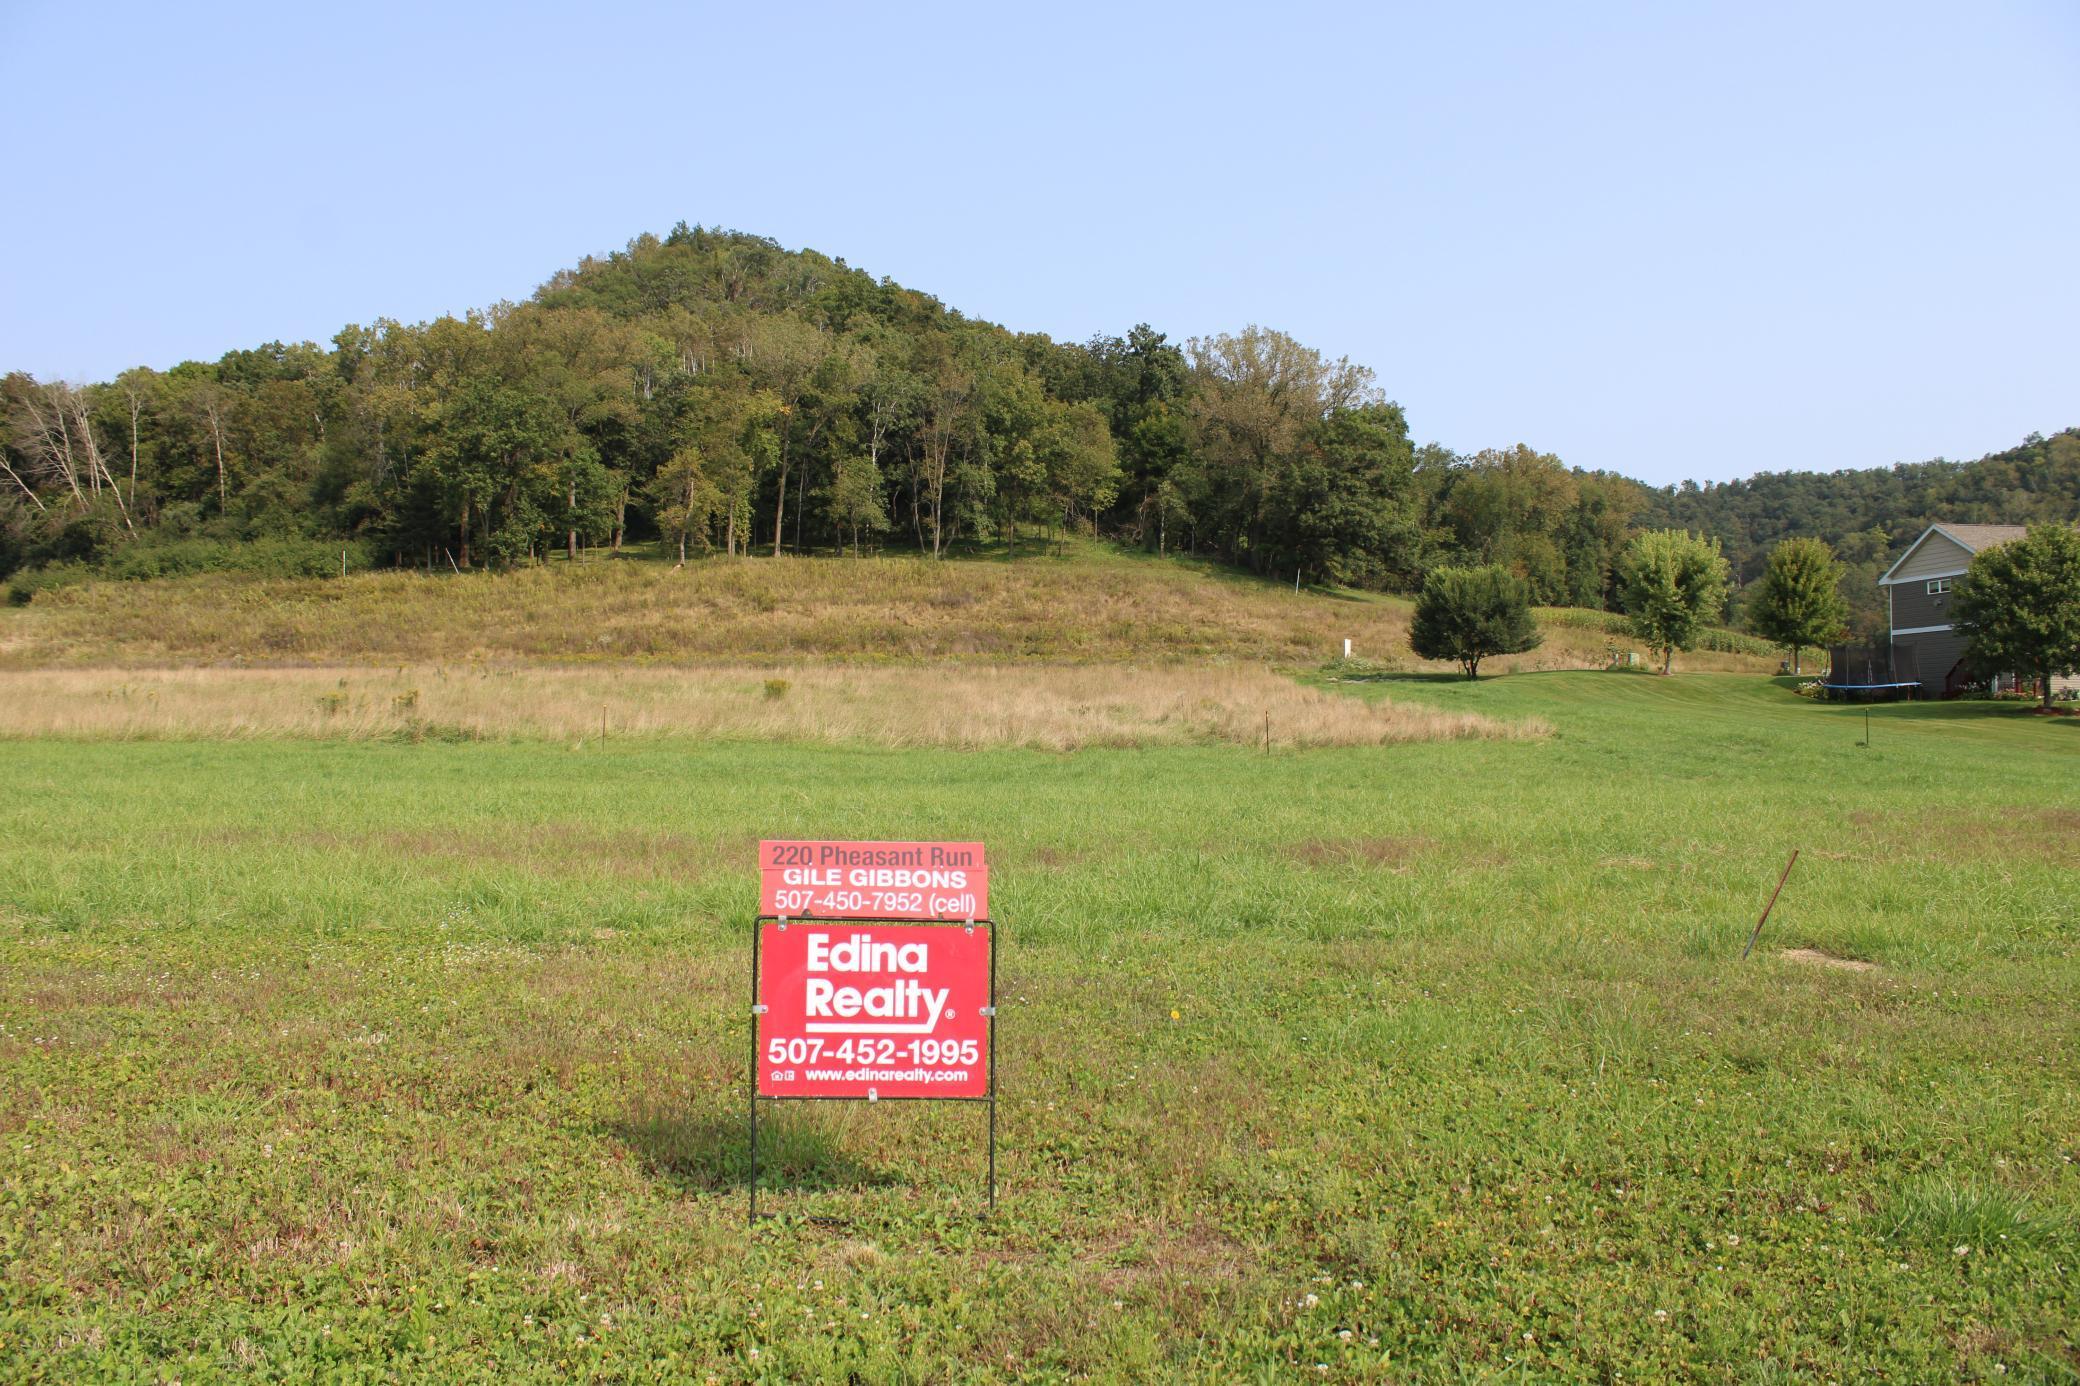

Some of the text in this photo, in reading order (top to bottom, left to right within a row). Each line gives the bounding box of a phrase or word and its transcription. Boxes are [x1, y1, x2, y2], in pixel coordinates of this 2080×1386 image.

[772, 846, 973, 867] 220 Pheasant Run
[783, 869, 967, 889] GILE GIBBONS
[775, 890, 976, 916] 507-450-7952 (cell)
[807, 933, 928, 973] Edina
[805, 978, 949, 1032] Realty
[768, 1038, 979, 1066] 507-452-1995
[805, 1067, 968, 1084] www.edinarealty.com
